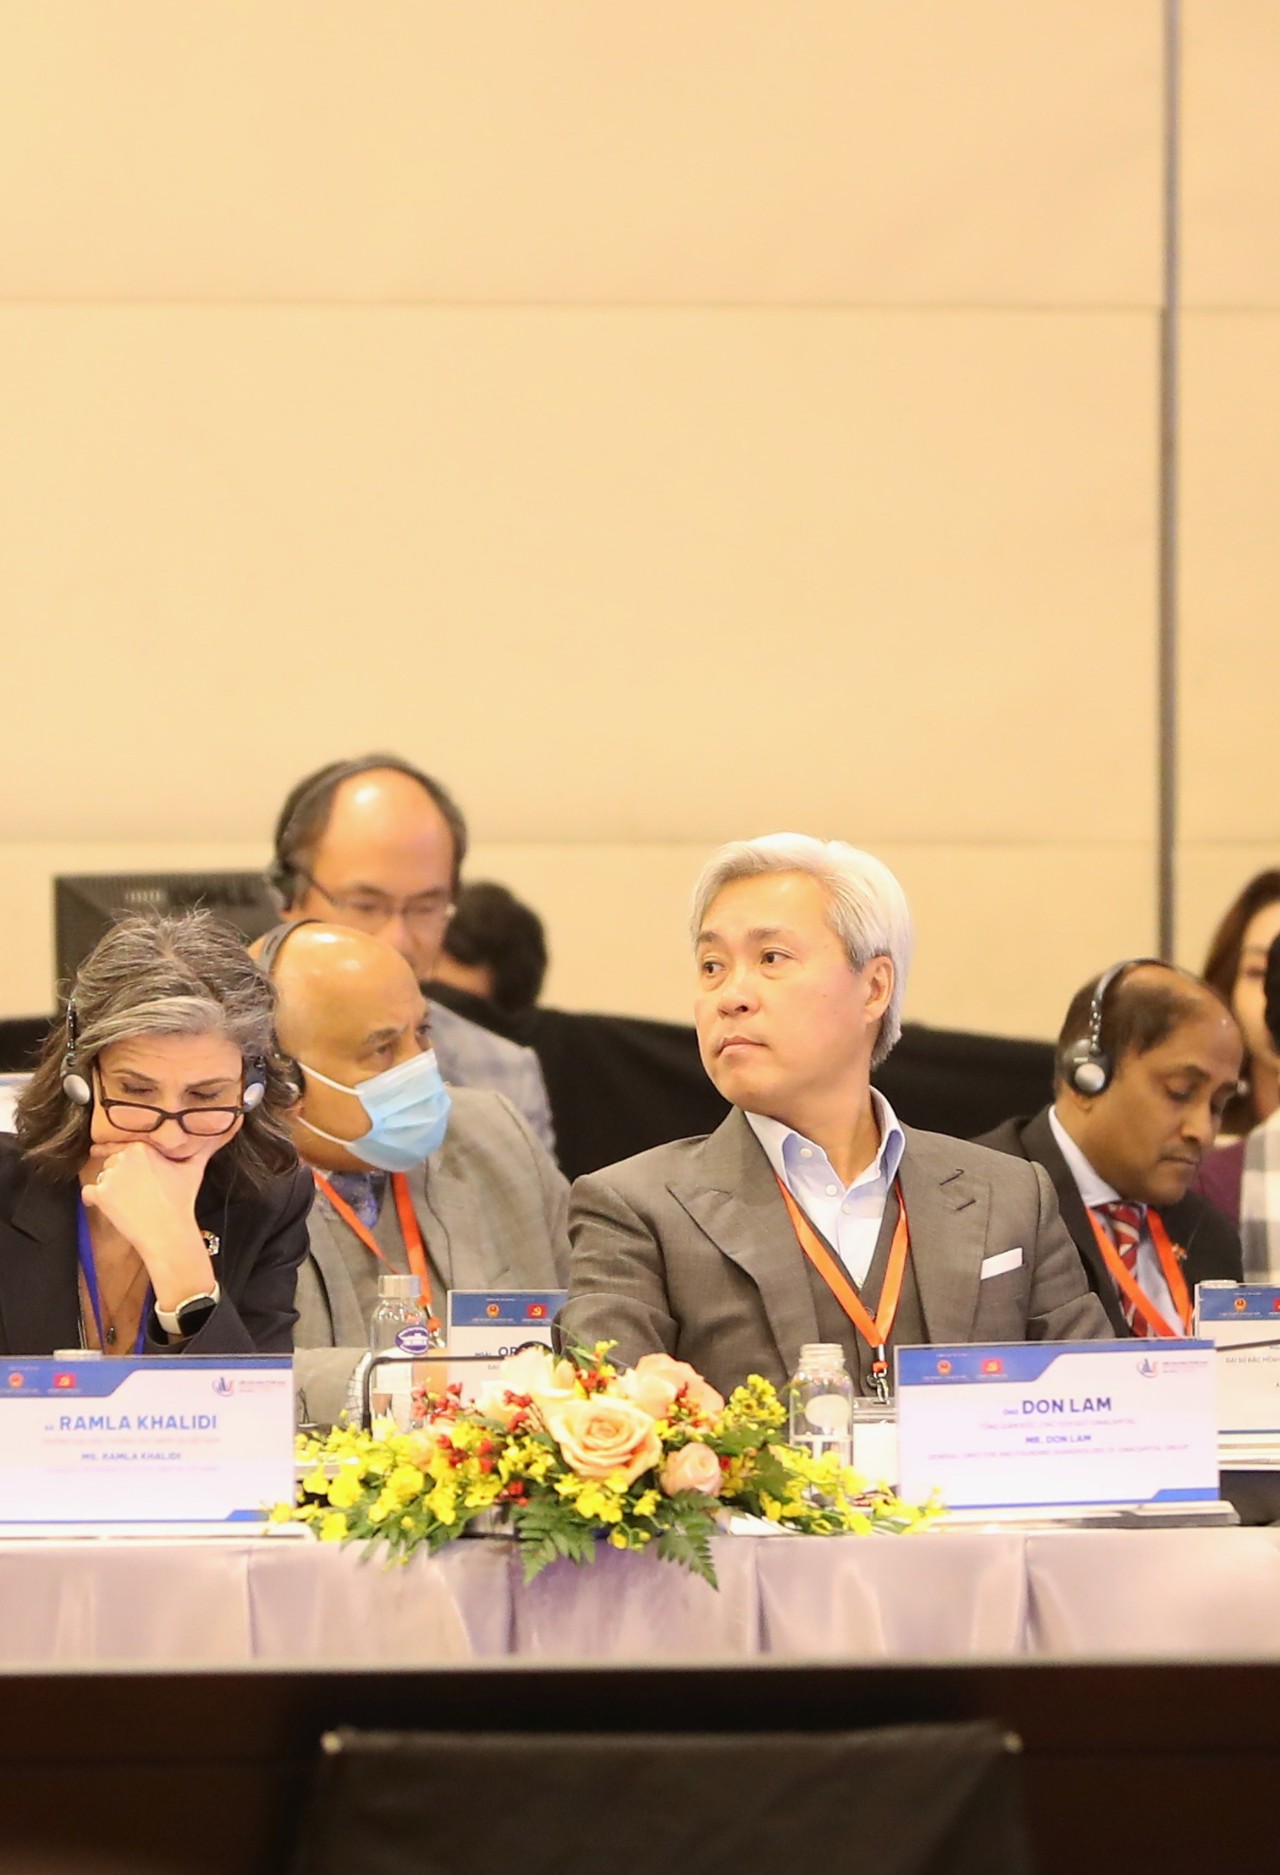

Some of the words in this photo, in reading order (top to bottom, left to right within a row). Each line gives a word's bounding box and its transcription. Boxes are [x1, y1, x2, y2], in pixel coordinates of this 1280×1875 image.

[1022, 1399, 1065, 1415] DON
[1069, 1397, 1113, 1413] LAM
[59, 1415, 132, 1431] RAMLA
[136, 1414, 218, 1430] KHALIDI
[1046, 1435, 1068, 1444] DON
[1070, 1434, 1092, 1443] LAM
[101, 1452, 138, 1461] RAMLA
[140, 1452, 182, 1461] KHALIDI
